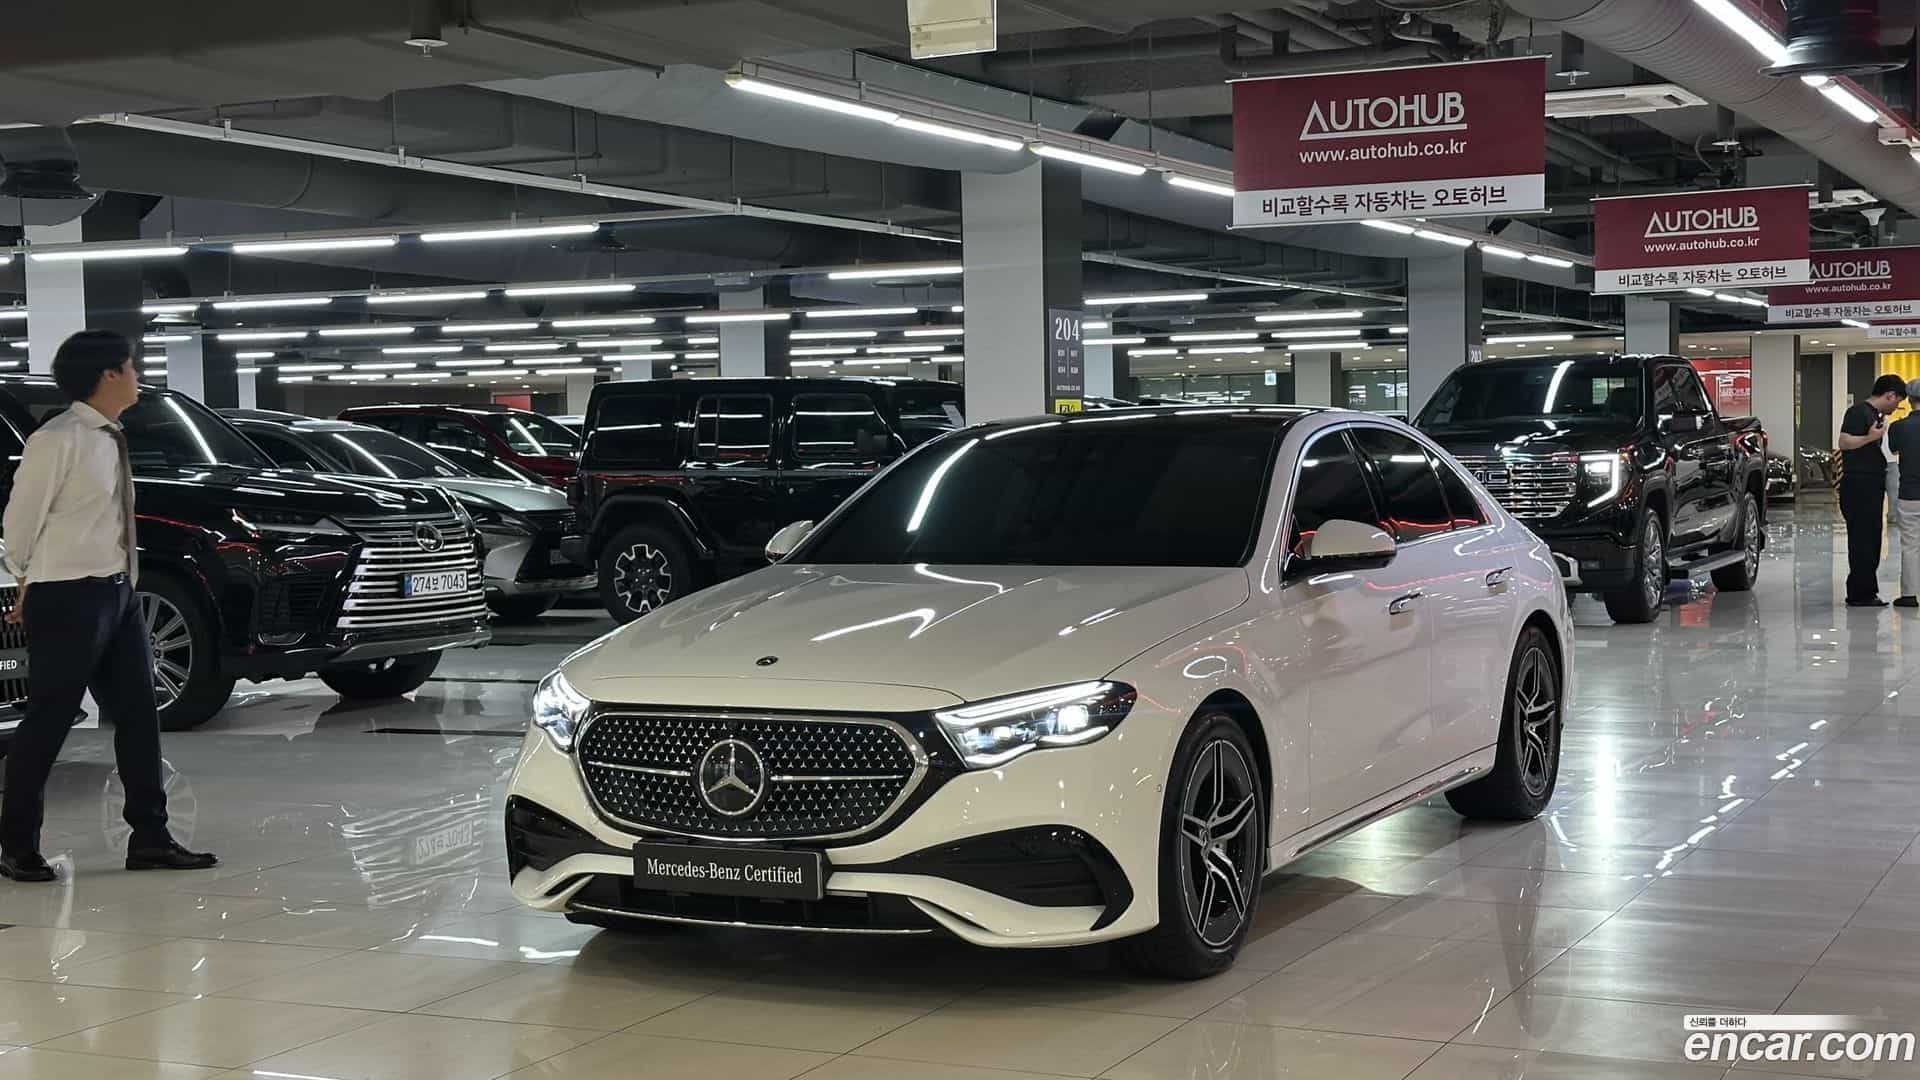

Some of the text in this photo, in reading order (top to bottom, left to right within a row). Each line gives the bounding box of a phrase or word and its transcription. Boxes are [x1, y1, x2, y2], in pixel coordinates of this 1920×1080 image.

[1300, 92, 1467, 140] AUTOHUB
[1300, 139, 1467, 163] www.autohub.co.kr
[1263, 185, 1507, 217] 비교할수록 자동차는 오토허브
[1644, 206, 1760, 238] AUTOHUB
[1644, 236, 1760, 253] www.autohub.co.kr
[1618, 266, 1788, 287] 비교할수록 자동차는 오토허브
[1809, 260, 1892, 281] AUTOHUB
[1805, 283, 1892, 293] www.autohub.co.kr
[1055, 317, 1080, 341] 204
[413, 573, 465, 593] 274보 7043
[647, 858, 802, 884] Mercedes-Benz Certified
